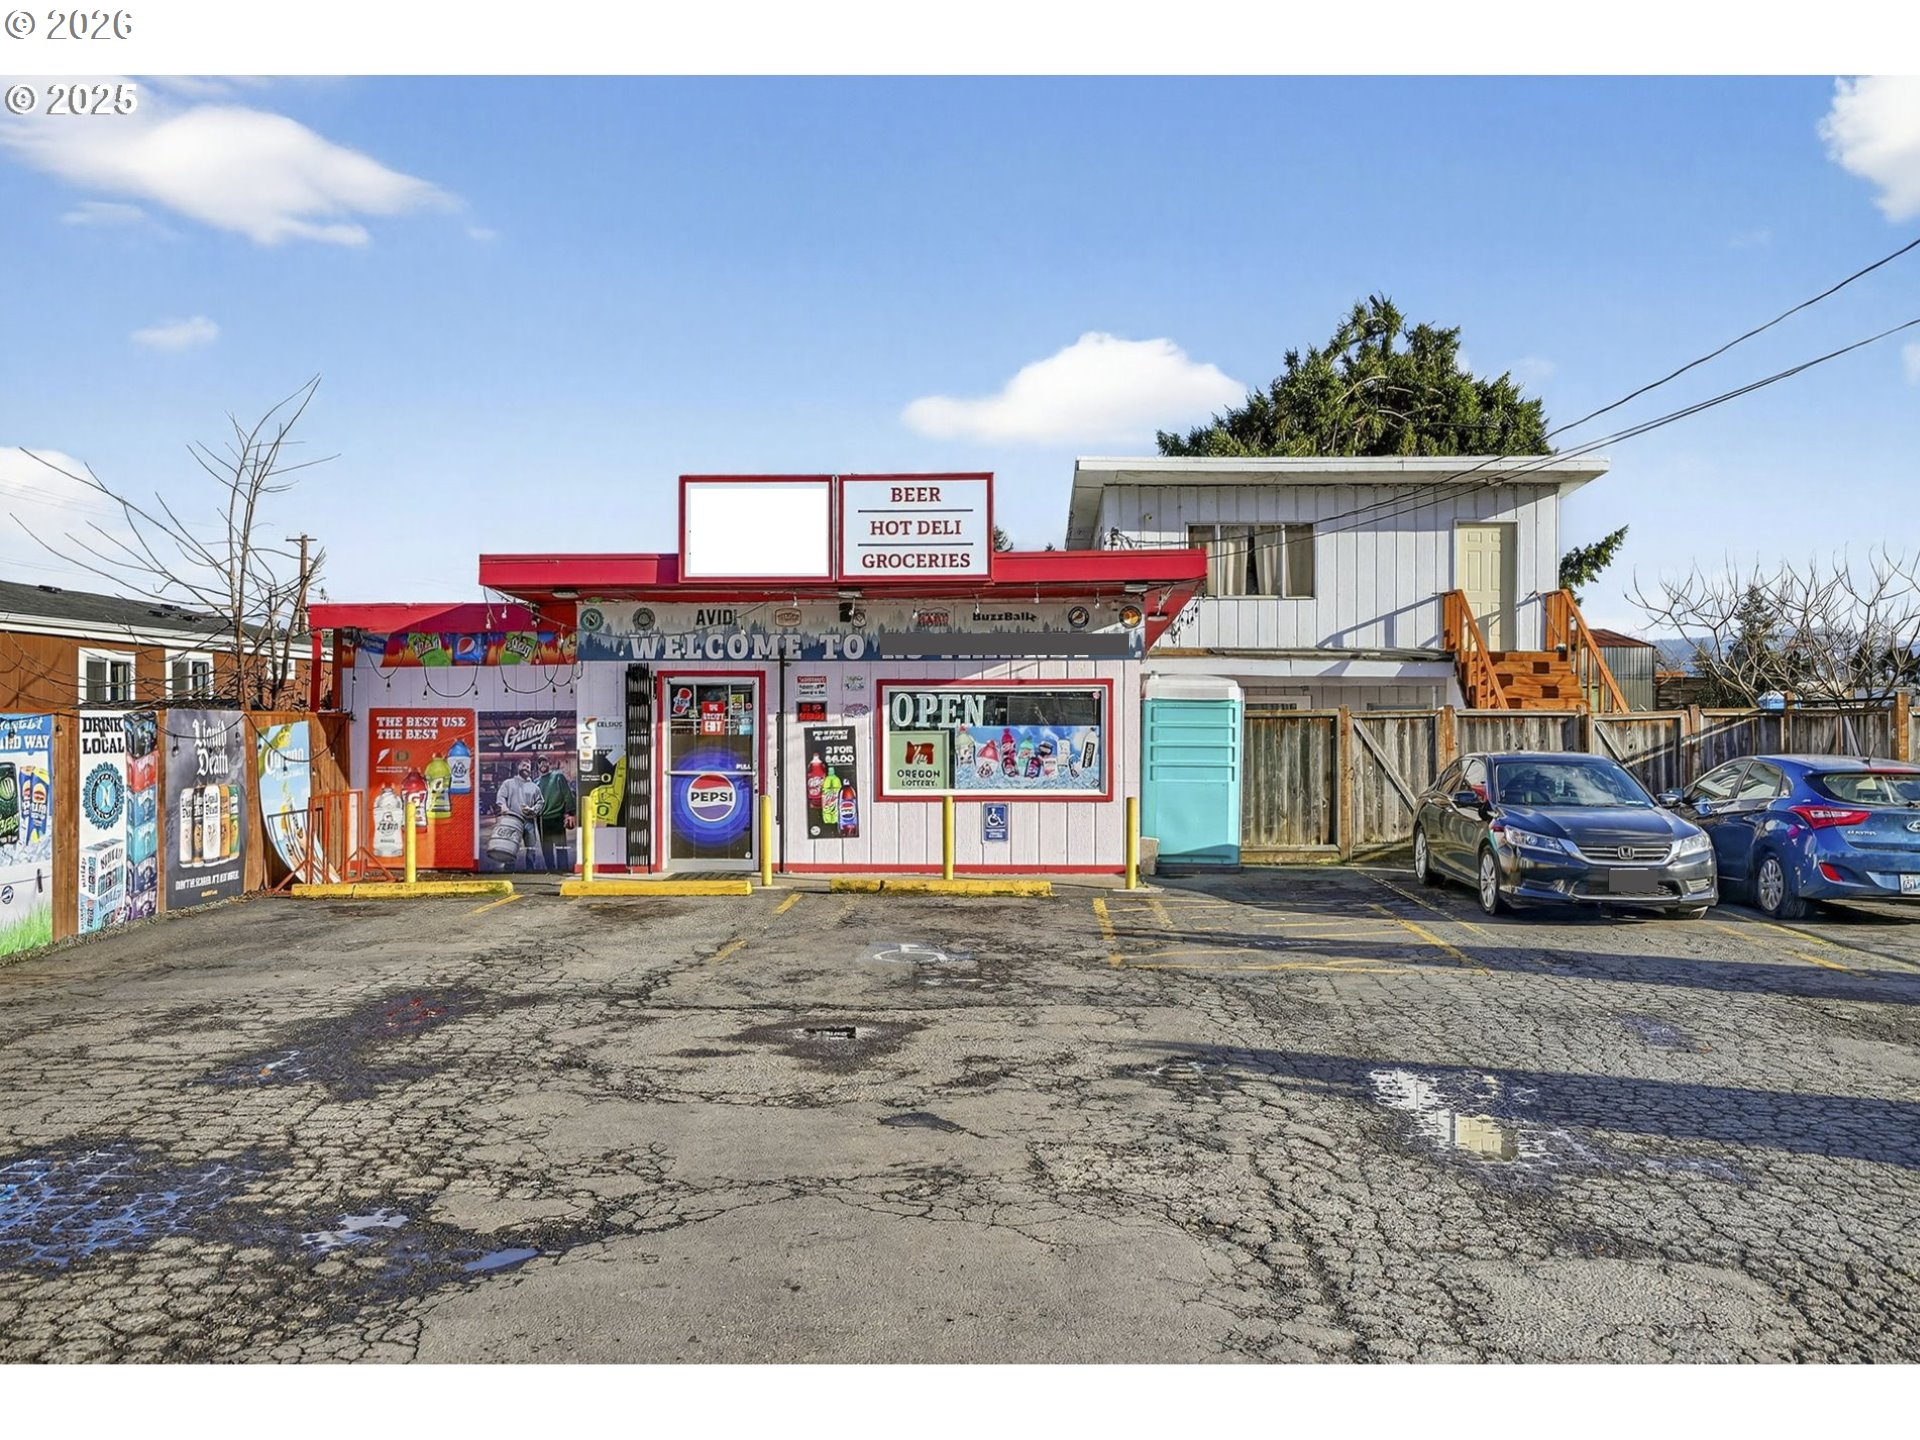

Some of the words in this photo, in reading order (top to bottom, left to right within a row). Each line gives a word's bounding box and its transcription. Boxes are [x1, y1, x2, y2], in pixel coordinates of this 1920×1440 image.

[891, 487, 941, 502] BEER
[870, 521, 912, 535] HOT
[917, 520, 962, 535] DELI
[862, 553, 971, 569] GROCERIES
[696, 609, 733, 625] AVID
[629, 634, 802, 660] WELCOME
[819, 634, 867, 660] TO
[892, 693, 986, 727] OPEN
[82, 717, 123, 732] DRINK
[376, 717, 403, 728] THE
[405, 717, 439, 728] BEST
[442, 717, 466, 728] USE
[24, 735, 50, 749] WAY
[376, 729, 403, 740] THE
[405, 729, 438, 740] BEST
[82, 738, 124, 754] LOCAL
[826, 746, 833, 754] 2
[897, 770, 940, 779] OREGON
[691, 792, 733, 803] PEPSI
